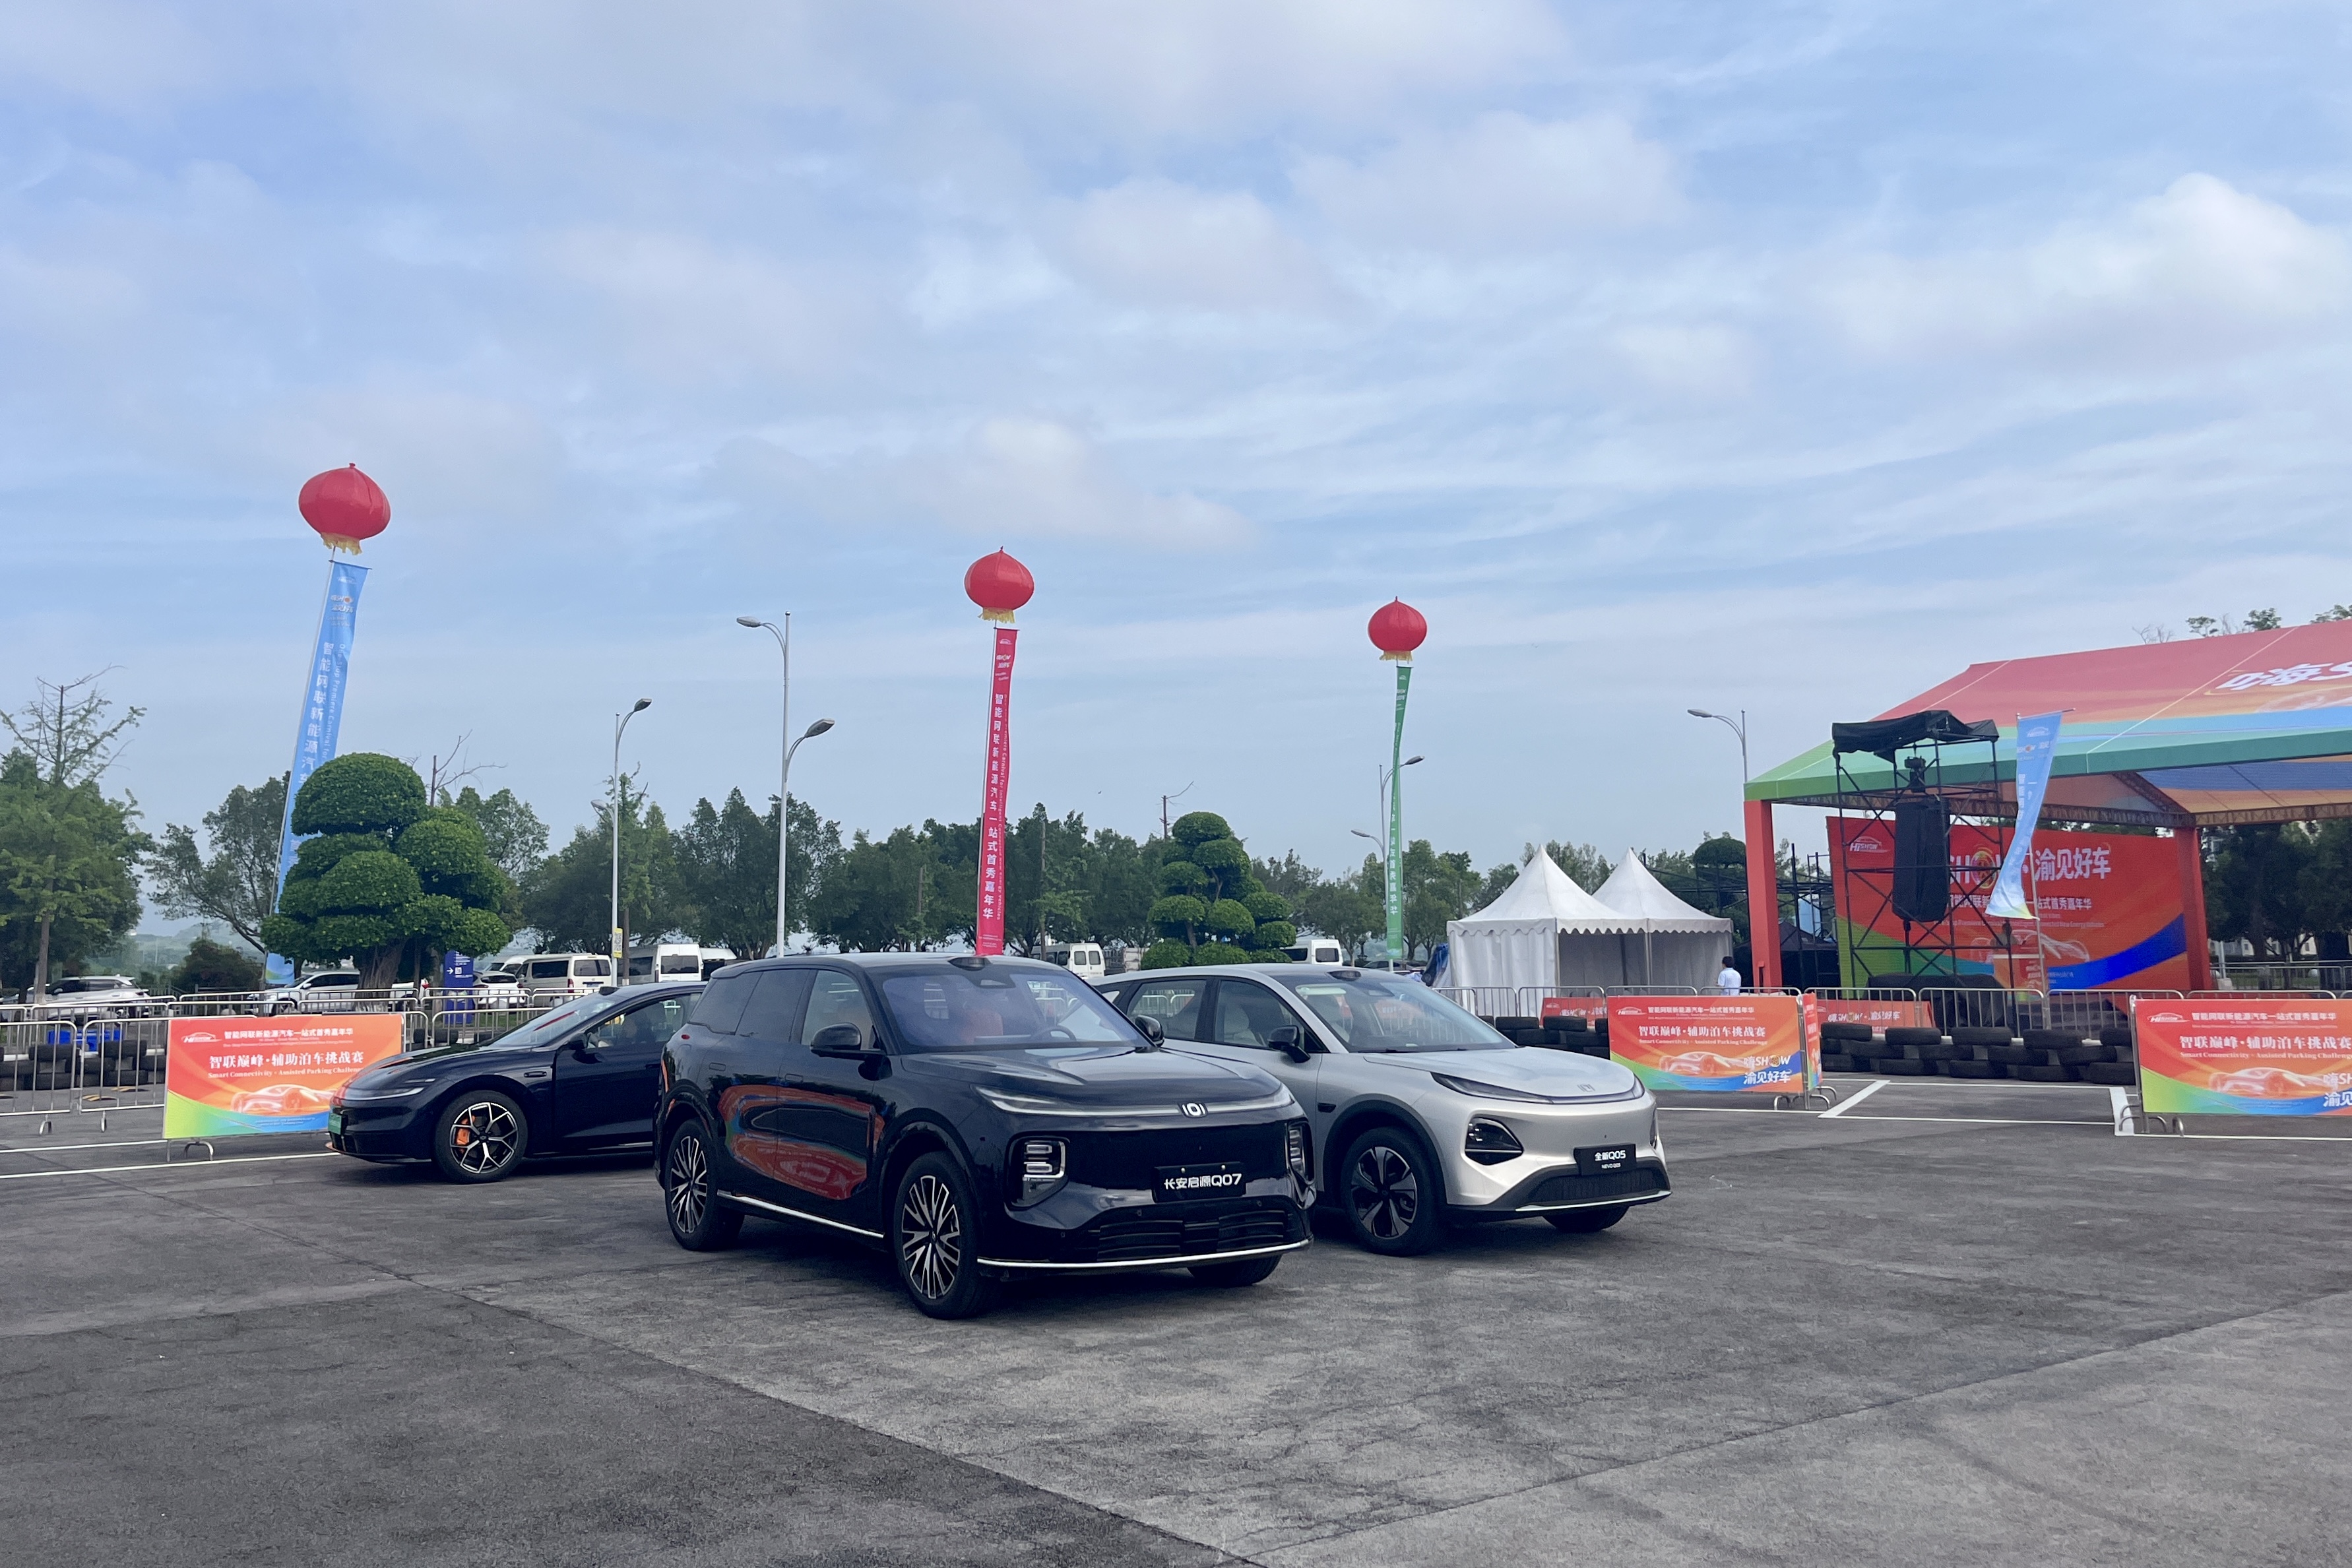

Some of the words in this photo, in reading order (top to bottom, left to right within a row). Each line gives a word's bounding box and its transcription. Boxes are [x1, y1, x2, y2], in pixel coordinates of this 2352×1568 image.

[2035, 846, 2112, 882] 渝见好车
[224, 1028, 354, 1040] 智能网联新能源汽车一站式首秀嘉年华
[1743, 1069, 1792, 1084] 渝见好车
[2323, 1092, 2352, 1107] 渝见
[1595, 1150, 1626, 1161] 全新Q05
[1164, 1173, 1242, 1190] 长安启源Q07
